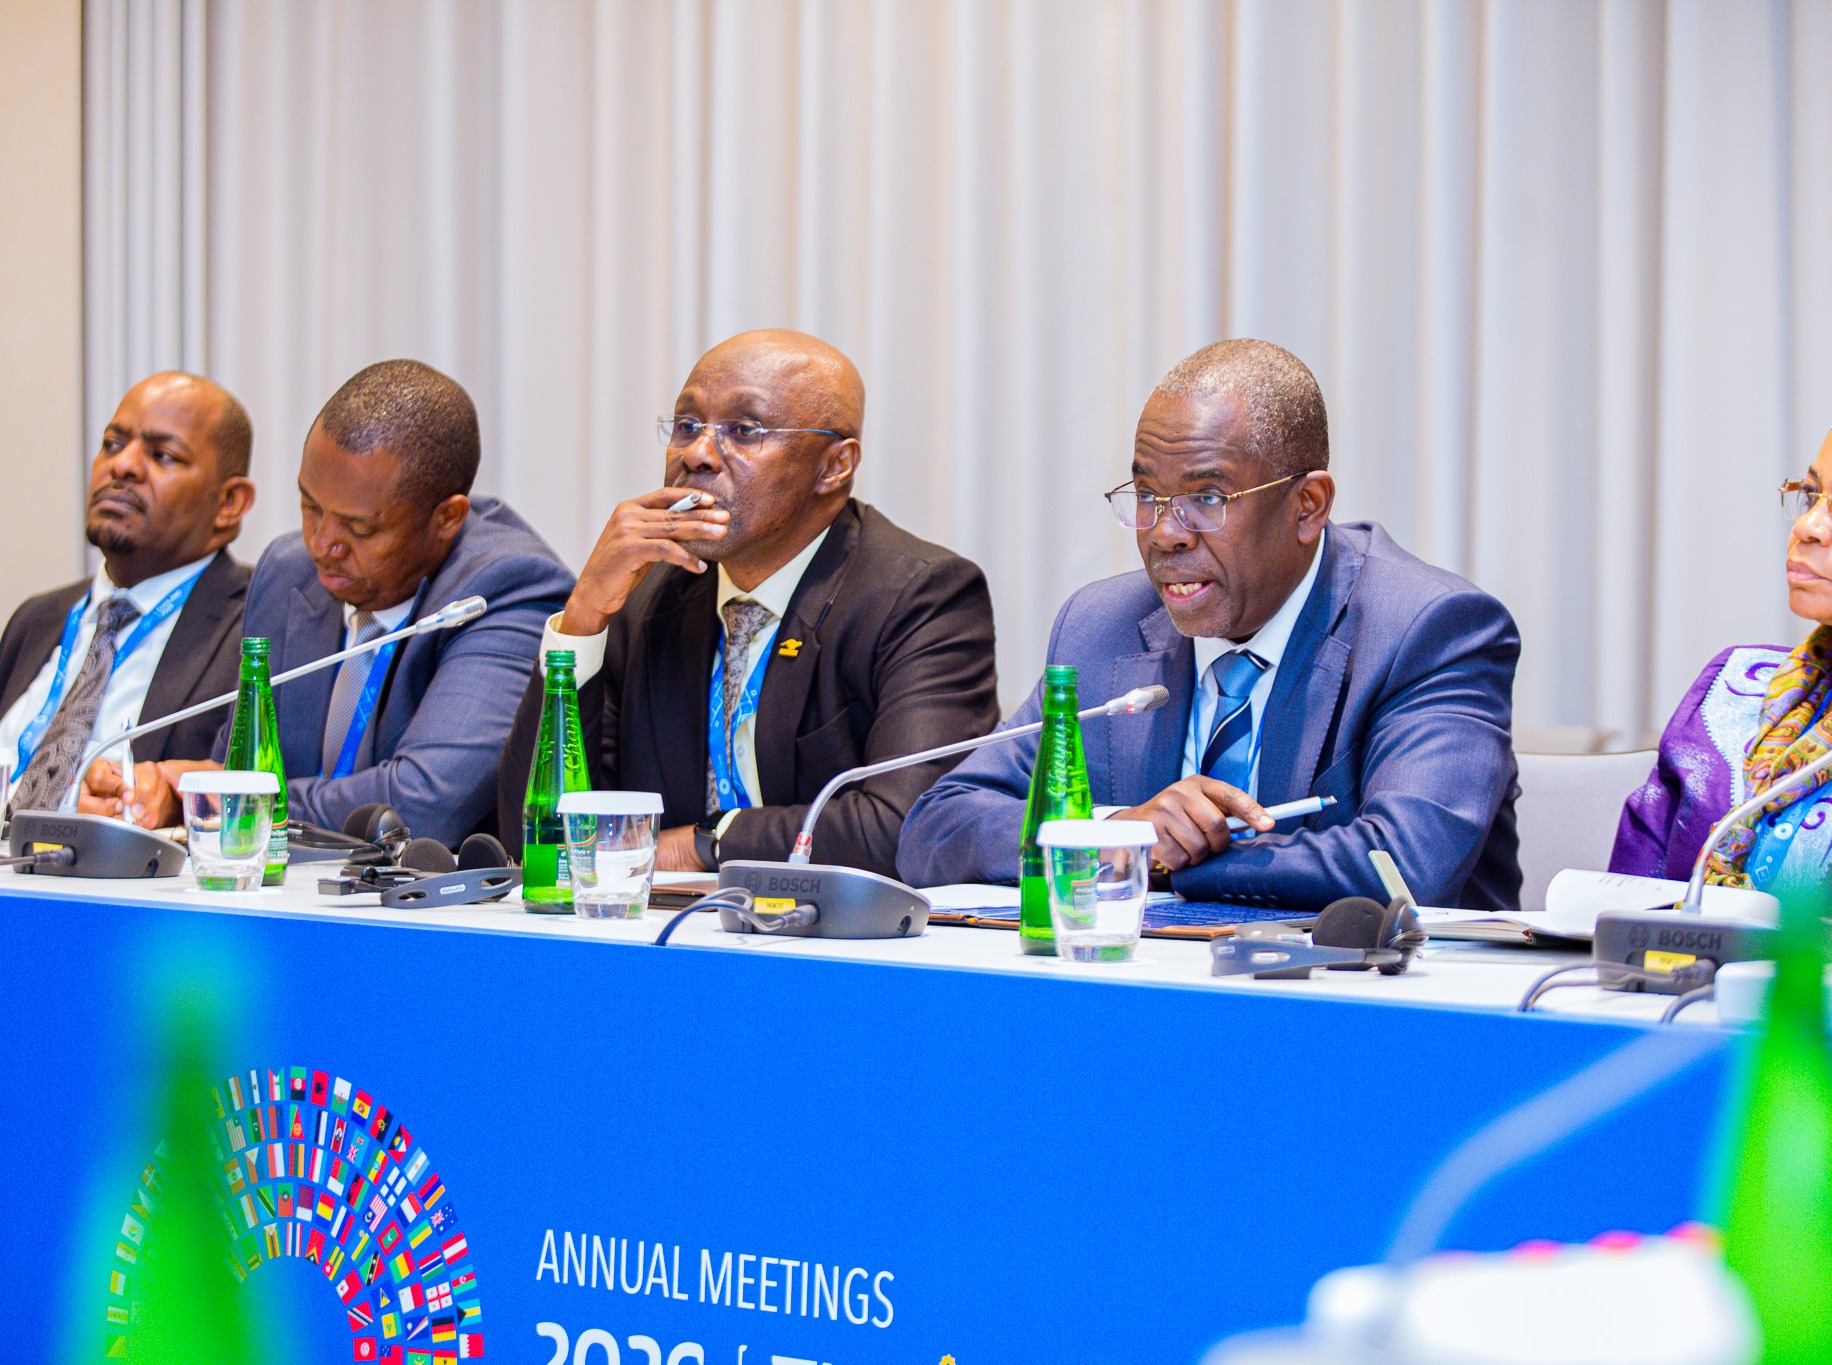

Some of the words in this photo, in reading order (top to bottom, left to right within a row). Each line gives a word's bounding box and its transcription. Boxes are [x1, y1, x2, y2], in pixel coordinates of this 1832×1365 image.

[40, 824, 78, 839] BOSCH
[768, 876, 820, 894] BOSCH
[1658, 929, 1722, 949] BOSCH
[535, 1228, 689, 1301] ANNUAL
[699, 1248, 895, 1329] MEETINGS
